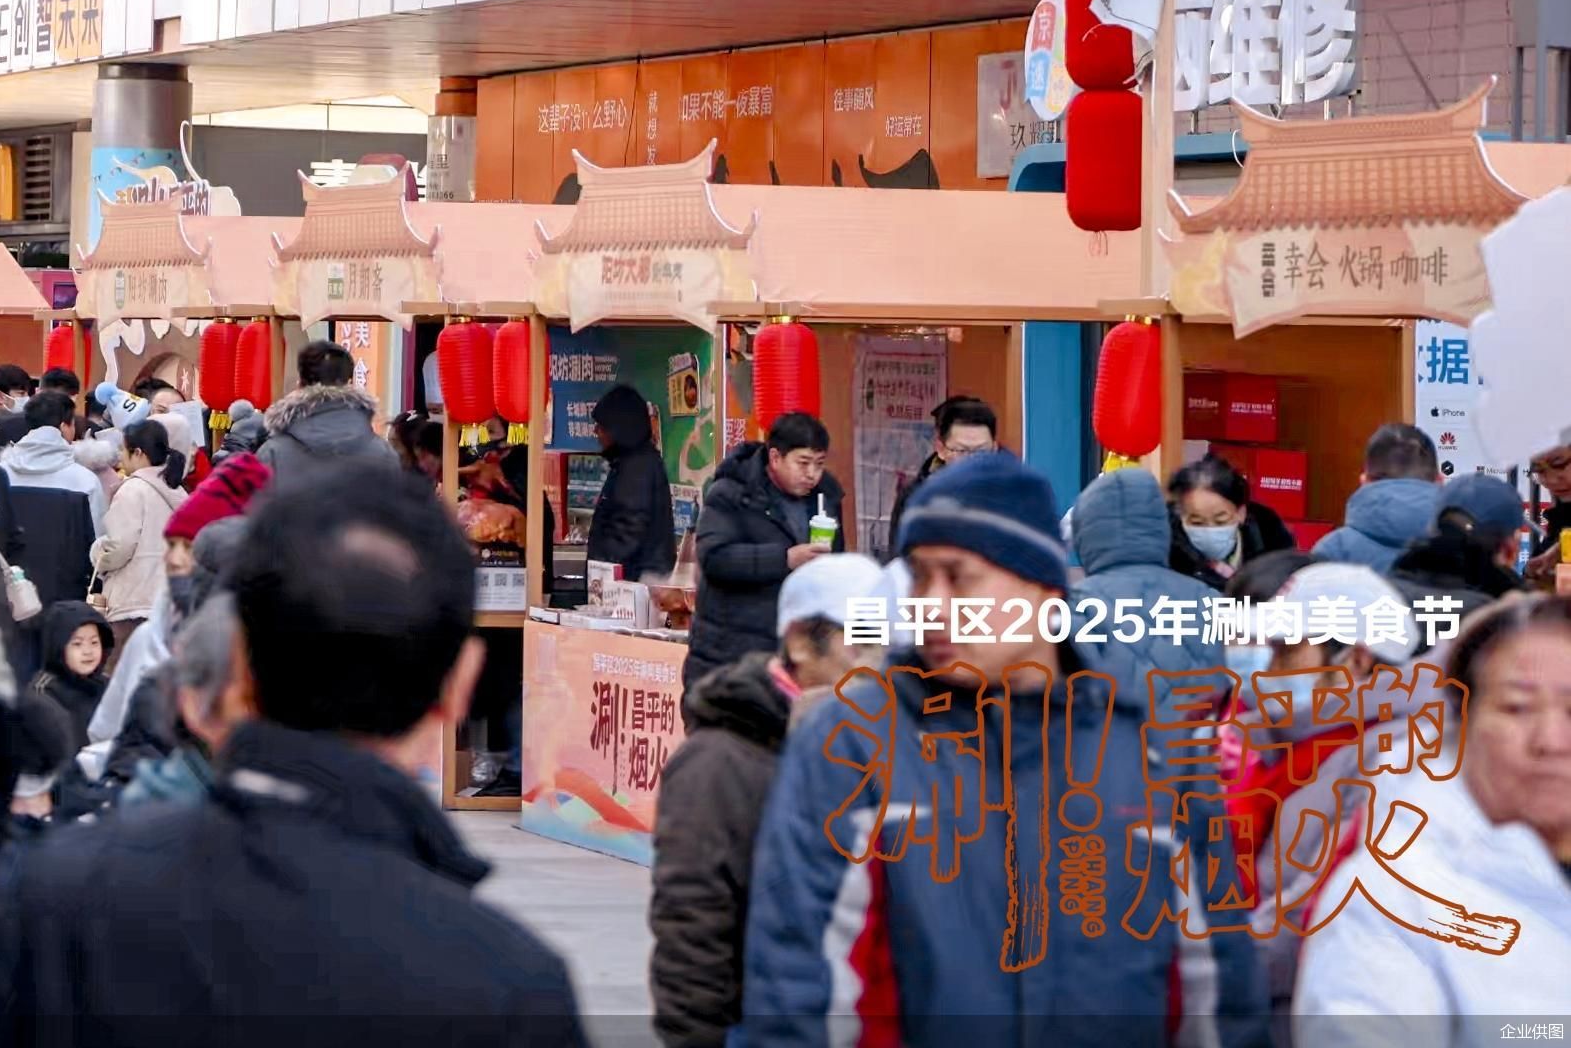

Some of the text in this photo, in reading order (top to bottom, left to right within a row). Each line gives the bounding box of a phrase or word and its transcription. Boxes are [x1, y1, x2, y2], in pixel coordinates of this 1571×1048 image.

[833, 87, 875, 112] 往事随风
[885, 114, 922, 138] 好运常在
[1283, 240, 1329, 290] 幸会
[1338, 244, 1384, 291] 火锅
[1390, 245, 1449, 287] 咖啡
[631, 689, 676, 735] 昌平的
